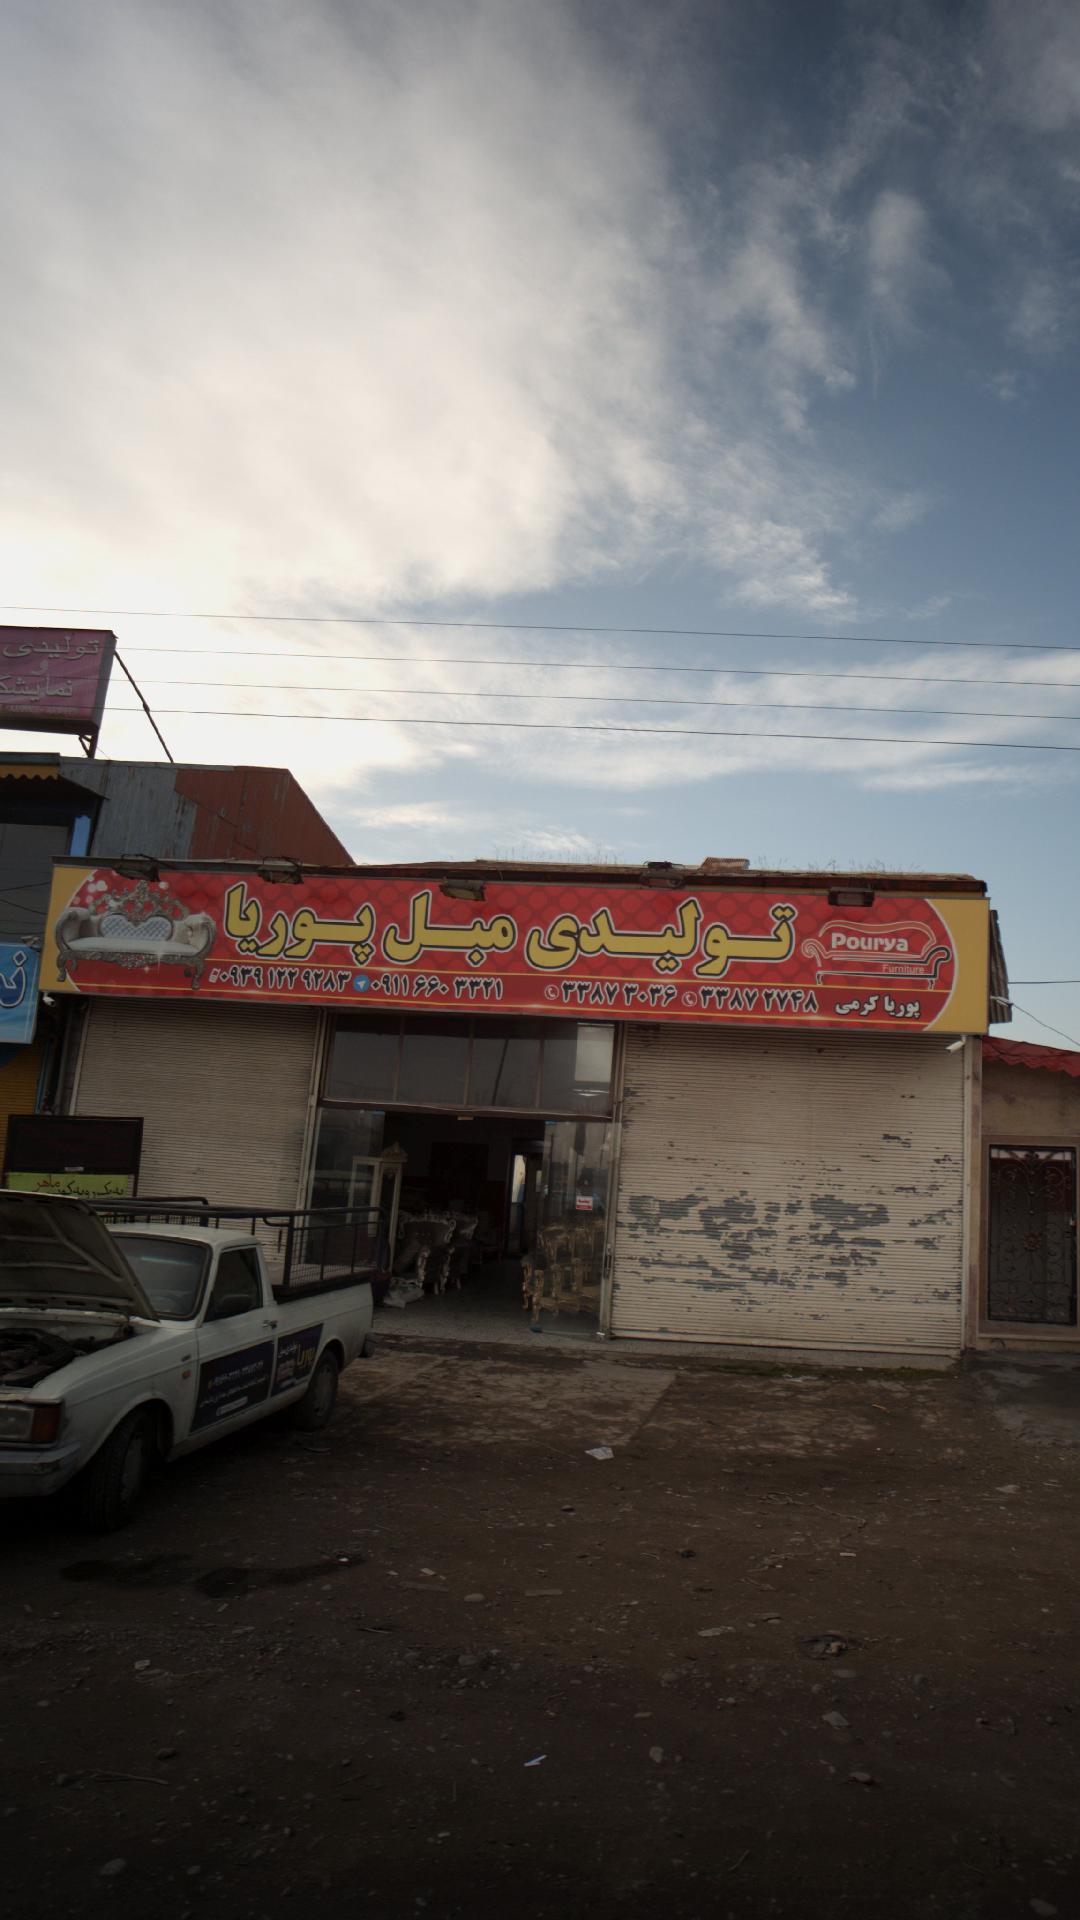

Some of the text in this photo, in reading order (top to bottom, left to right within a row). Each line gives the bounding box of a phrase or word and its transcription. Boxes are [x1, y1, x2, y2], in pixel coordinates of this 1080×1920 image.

[2, 636, 100, 660] تولیدی
[224, 881, 799, 978] تولیدی مبل پوریا
[831, 932, 909, 952] Pourya
[882, 963, 925, 975] Furniture
[834, 994, 920, 1019] پوریا کرمی
